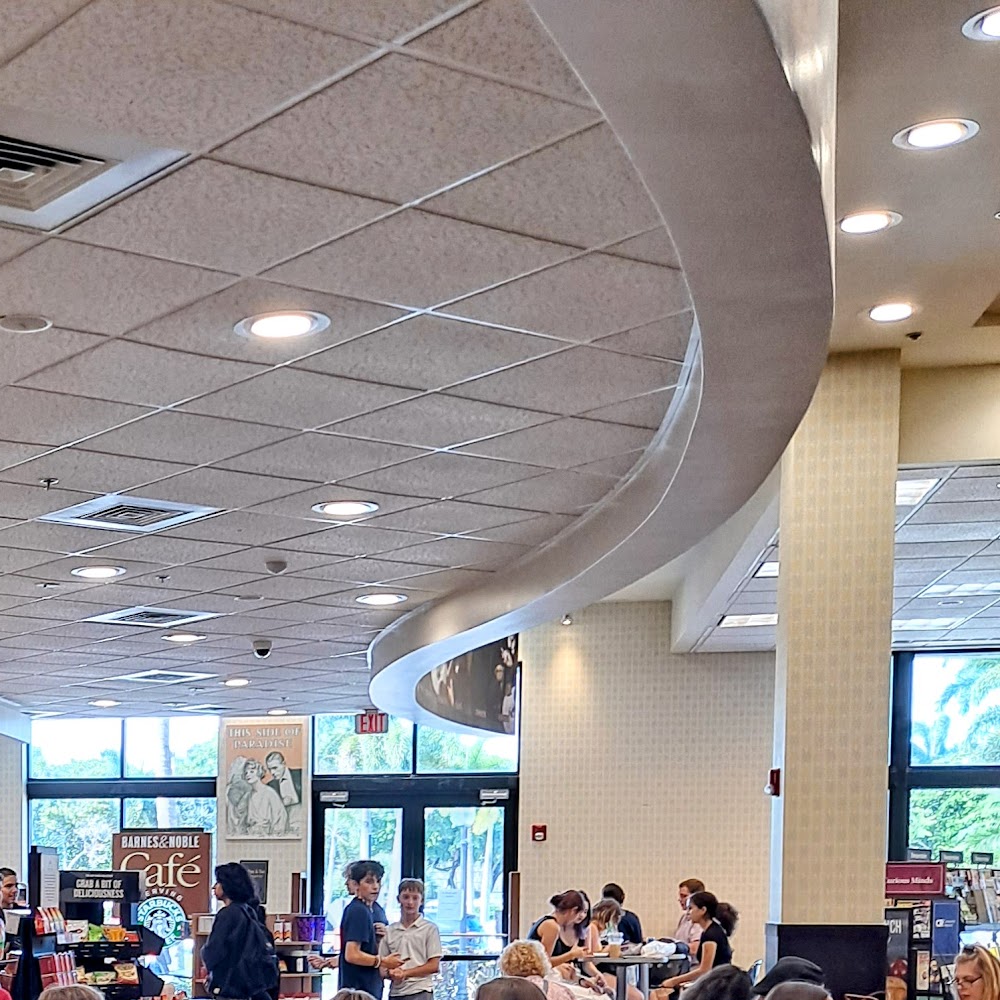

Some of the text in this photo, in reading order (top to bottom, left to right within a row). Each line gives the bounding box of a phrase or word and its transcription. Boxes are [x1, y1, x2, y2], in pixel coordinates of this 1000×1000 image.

[360, 713, 384, 733] EXIT
[229, 727, 301, 737] THIS SIDE OF
[233, 739, 291, 749] PARADISE
[120, 852, 201, 888] Café
[76, 879, 94, 889] GRAB
[113, 879, 122, 889] OF
[887, 877, 910, 885] urious
[73, 888, 125, 899] DELICIOUSNESS
[145, 887, 184, 902] ERVING
[138, 899, 184, 923] STARBUCKS
